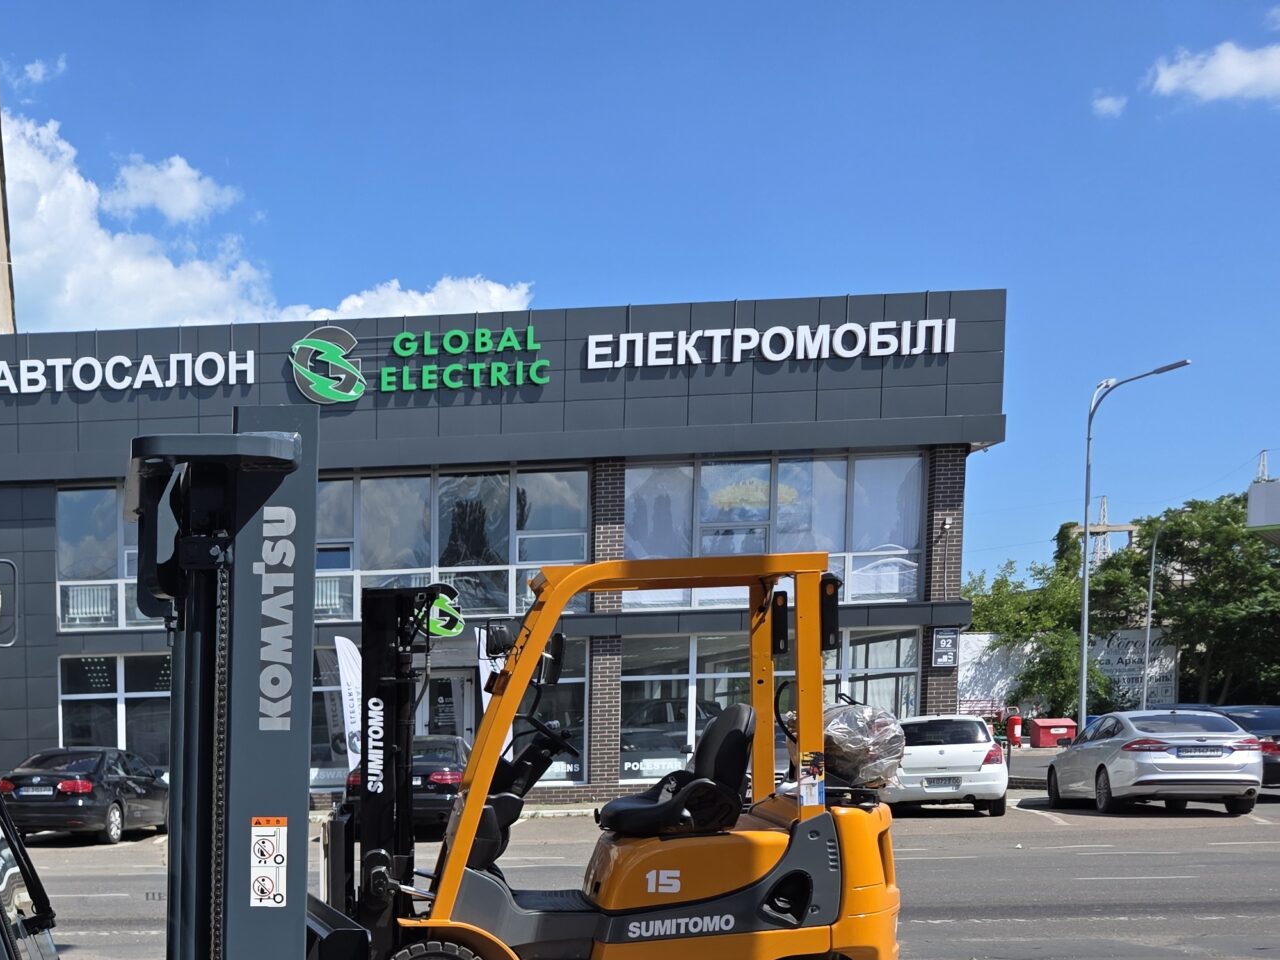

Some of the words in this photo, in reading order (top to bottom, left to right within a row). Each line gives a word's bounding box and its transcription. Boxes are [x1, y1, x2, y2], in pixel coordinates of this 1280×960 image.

[392, 325, 542, 358] GLOBAL
[587, 318, 956, 370] ЕЛЕКТРОМОБІЛІ
[380, 359, 551, 393] ELECTRIC
[252, 506, 297, 731] KOMATSU
[940, 638, 953, 648] 92
[367, 696, 384, 794] SUMITOMO
[624, 761, 683, 772] POLESTAR
[645, 869, 681, 893] 15
[627, 914, 736, 938] SUMITOMO
